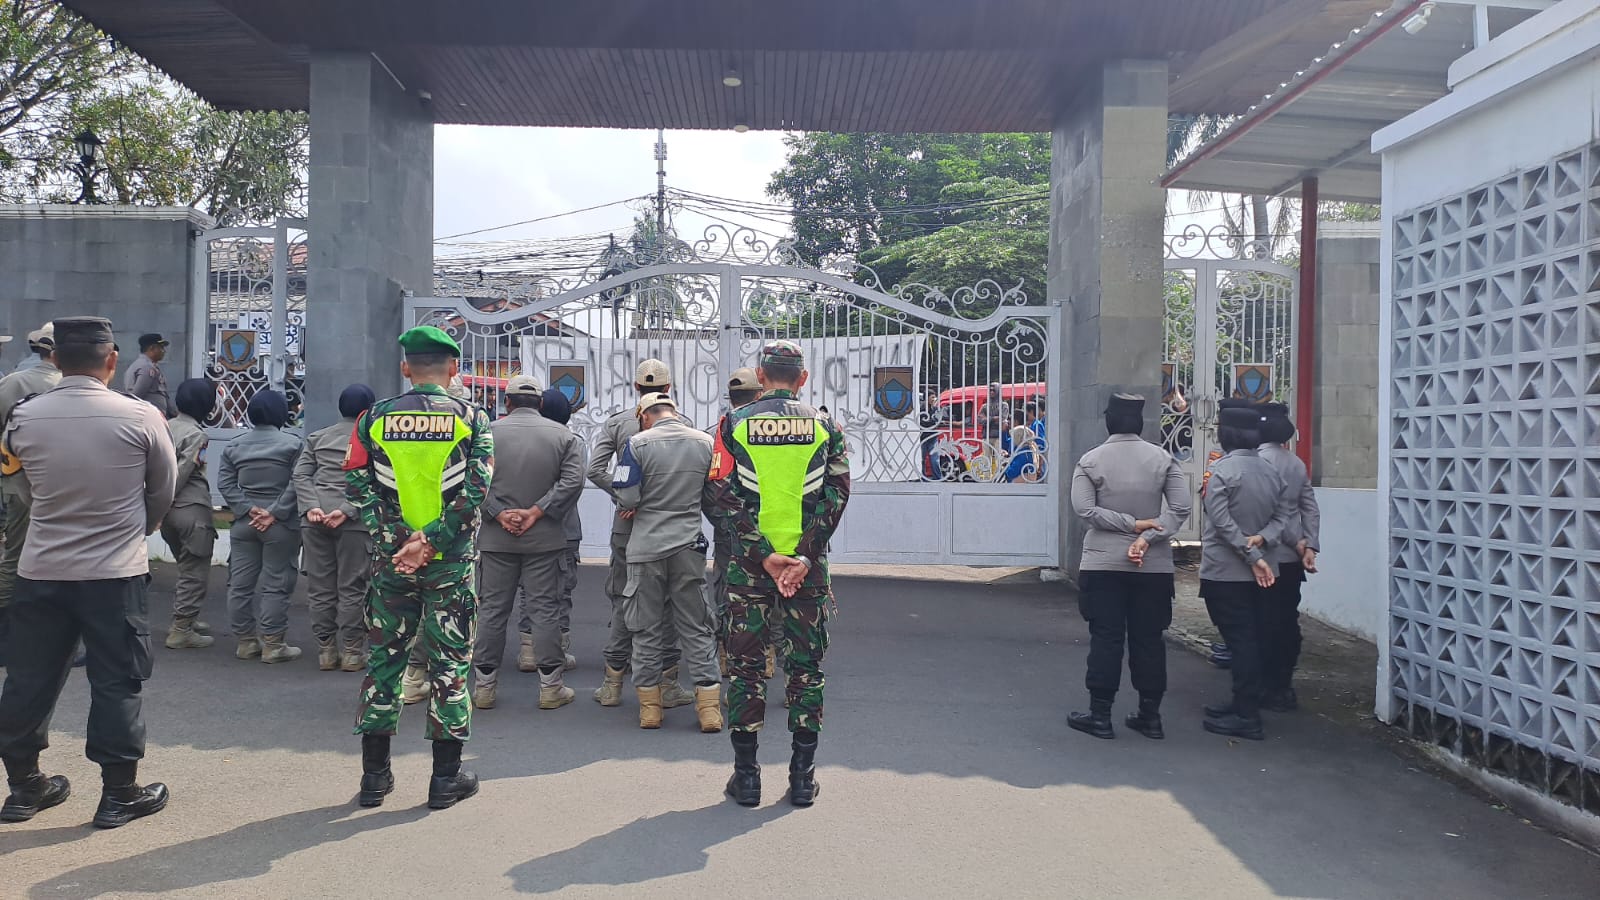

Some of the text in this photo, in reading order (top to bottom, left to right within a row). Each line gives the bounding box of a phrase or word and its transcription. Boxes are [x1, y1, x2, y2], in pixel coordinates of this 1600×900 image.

[384, 415, 453, 433] KODIM
[748, 419, 813, 436] KODIM
[384, 432, 452, 440] 0608/CJR
[749, 434, 813, 443] 0608/CJR
